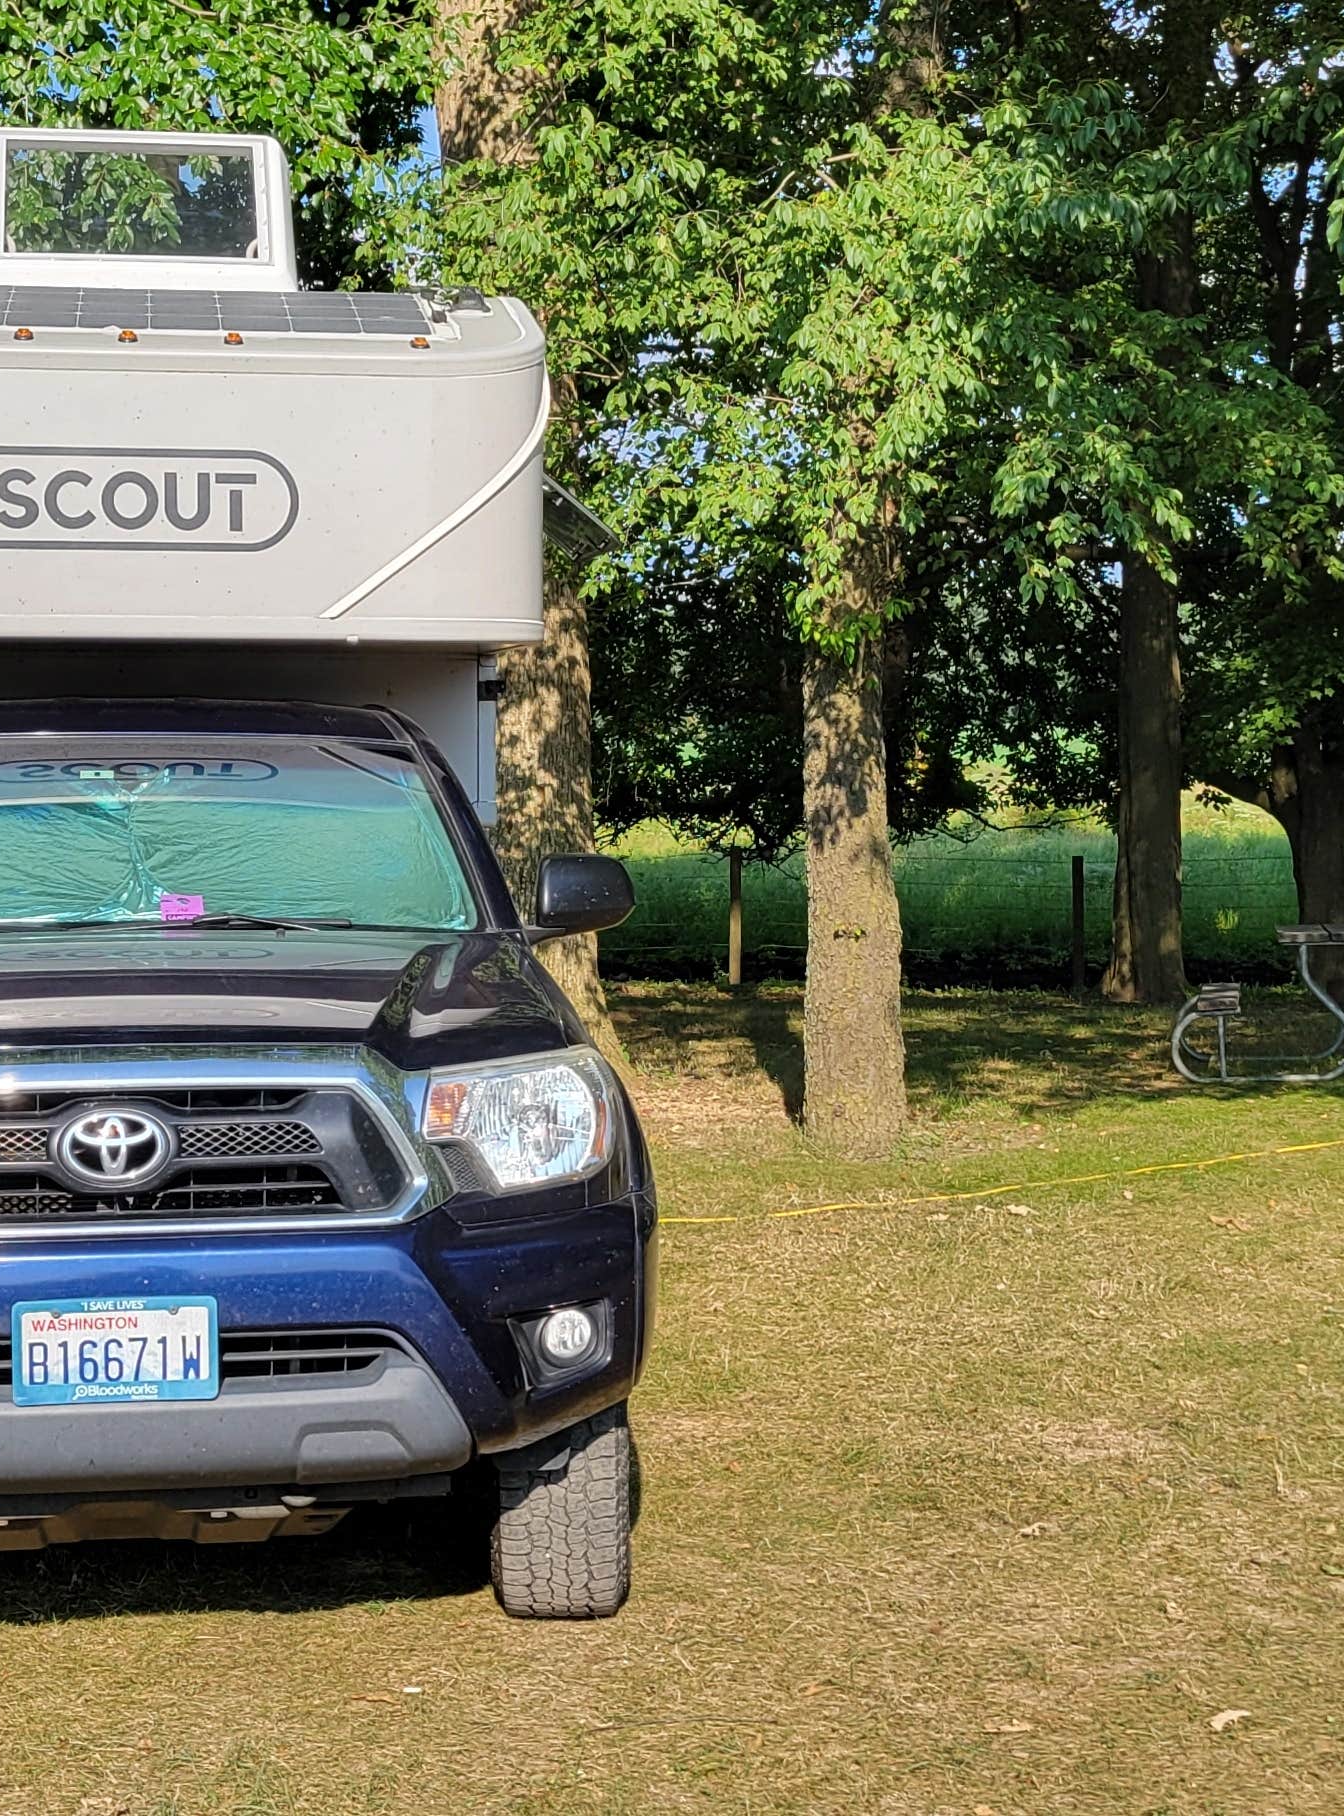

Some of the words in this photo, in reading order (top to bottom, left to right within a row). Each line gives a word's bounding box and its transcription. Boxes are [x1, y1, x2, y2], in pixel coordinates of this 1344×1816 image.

[89, 1301, 115, 1311] SAVE
[32, 1317, 138, 1332] WASHINGTON
[28, 1335, 201, 1385] B16671W
[87, 1383, 159, 1397] Bloodworks
